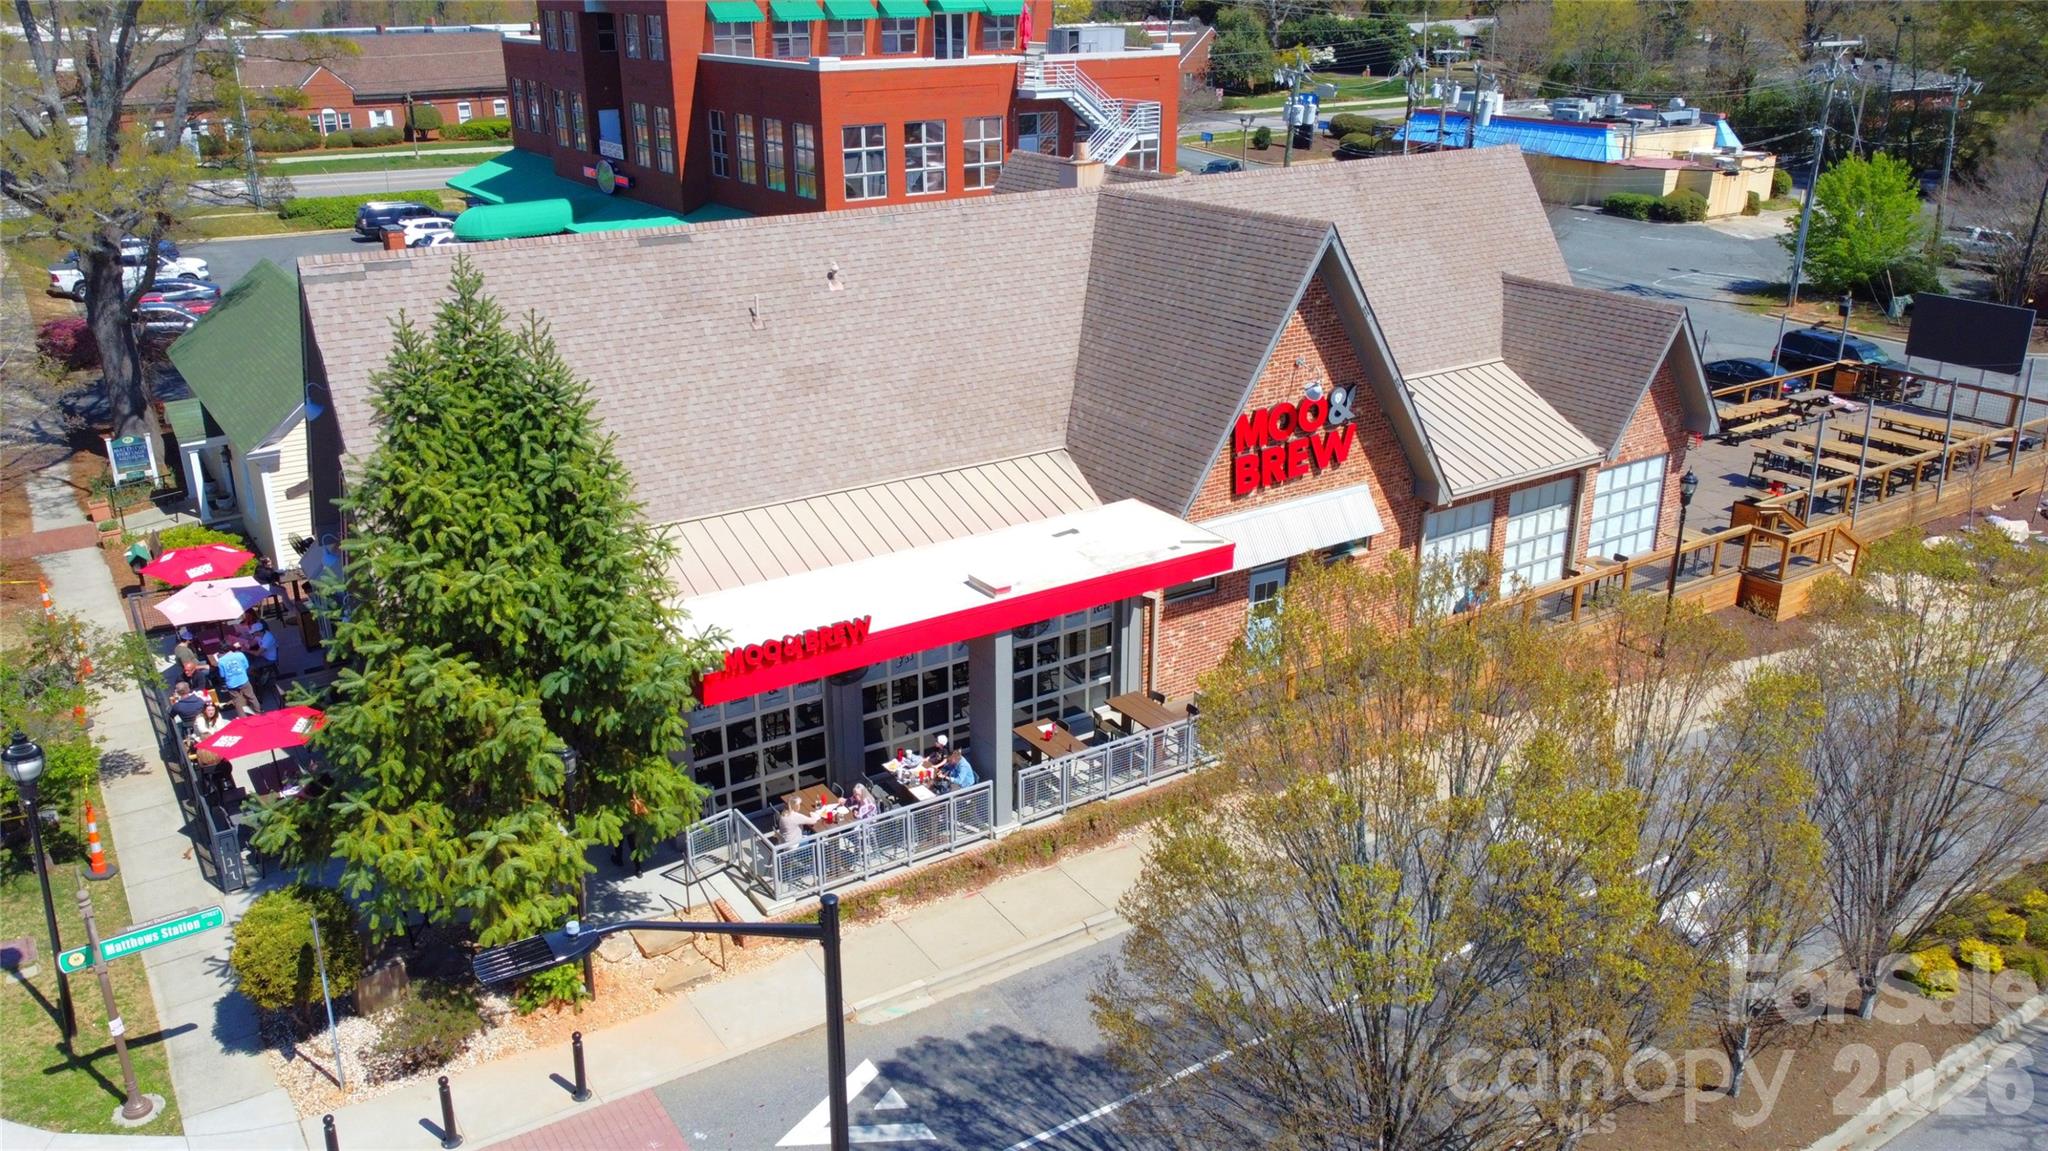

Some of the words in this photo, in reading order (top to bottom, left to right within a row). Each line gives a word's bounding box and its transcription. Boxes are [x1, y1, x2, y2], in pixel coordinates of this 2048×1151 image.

[1236, 422, 1358, 495] BREW
[104, 931, 160, 956] Matthews
[160, 919, 201, 939] Station
